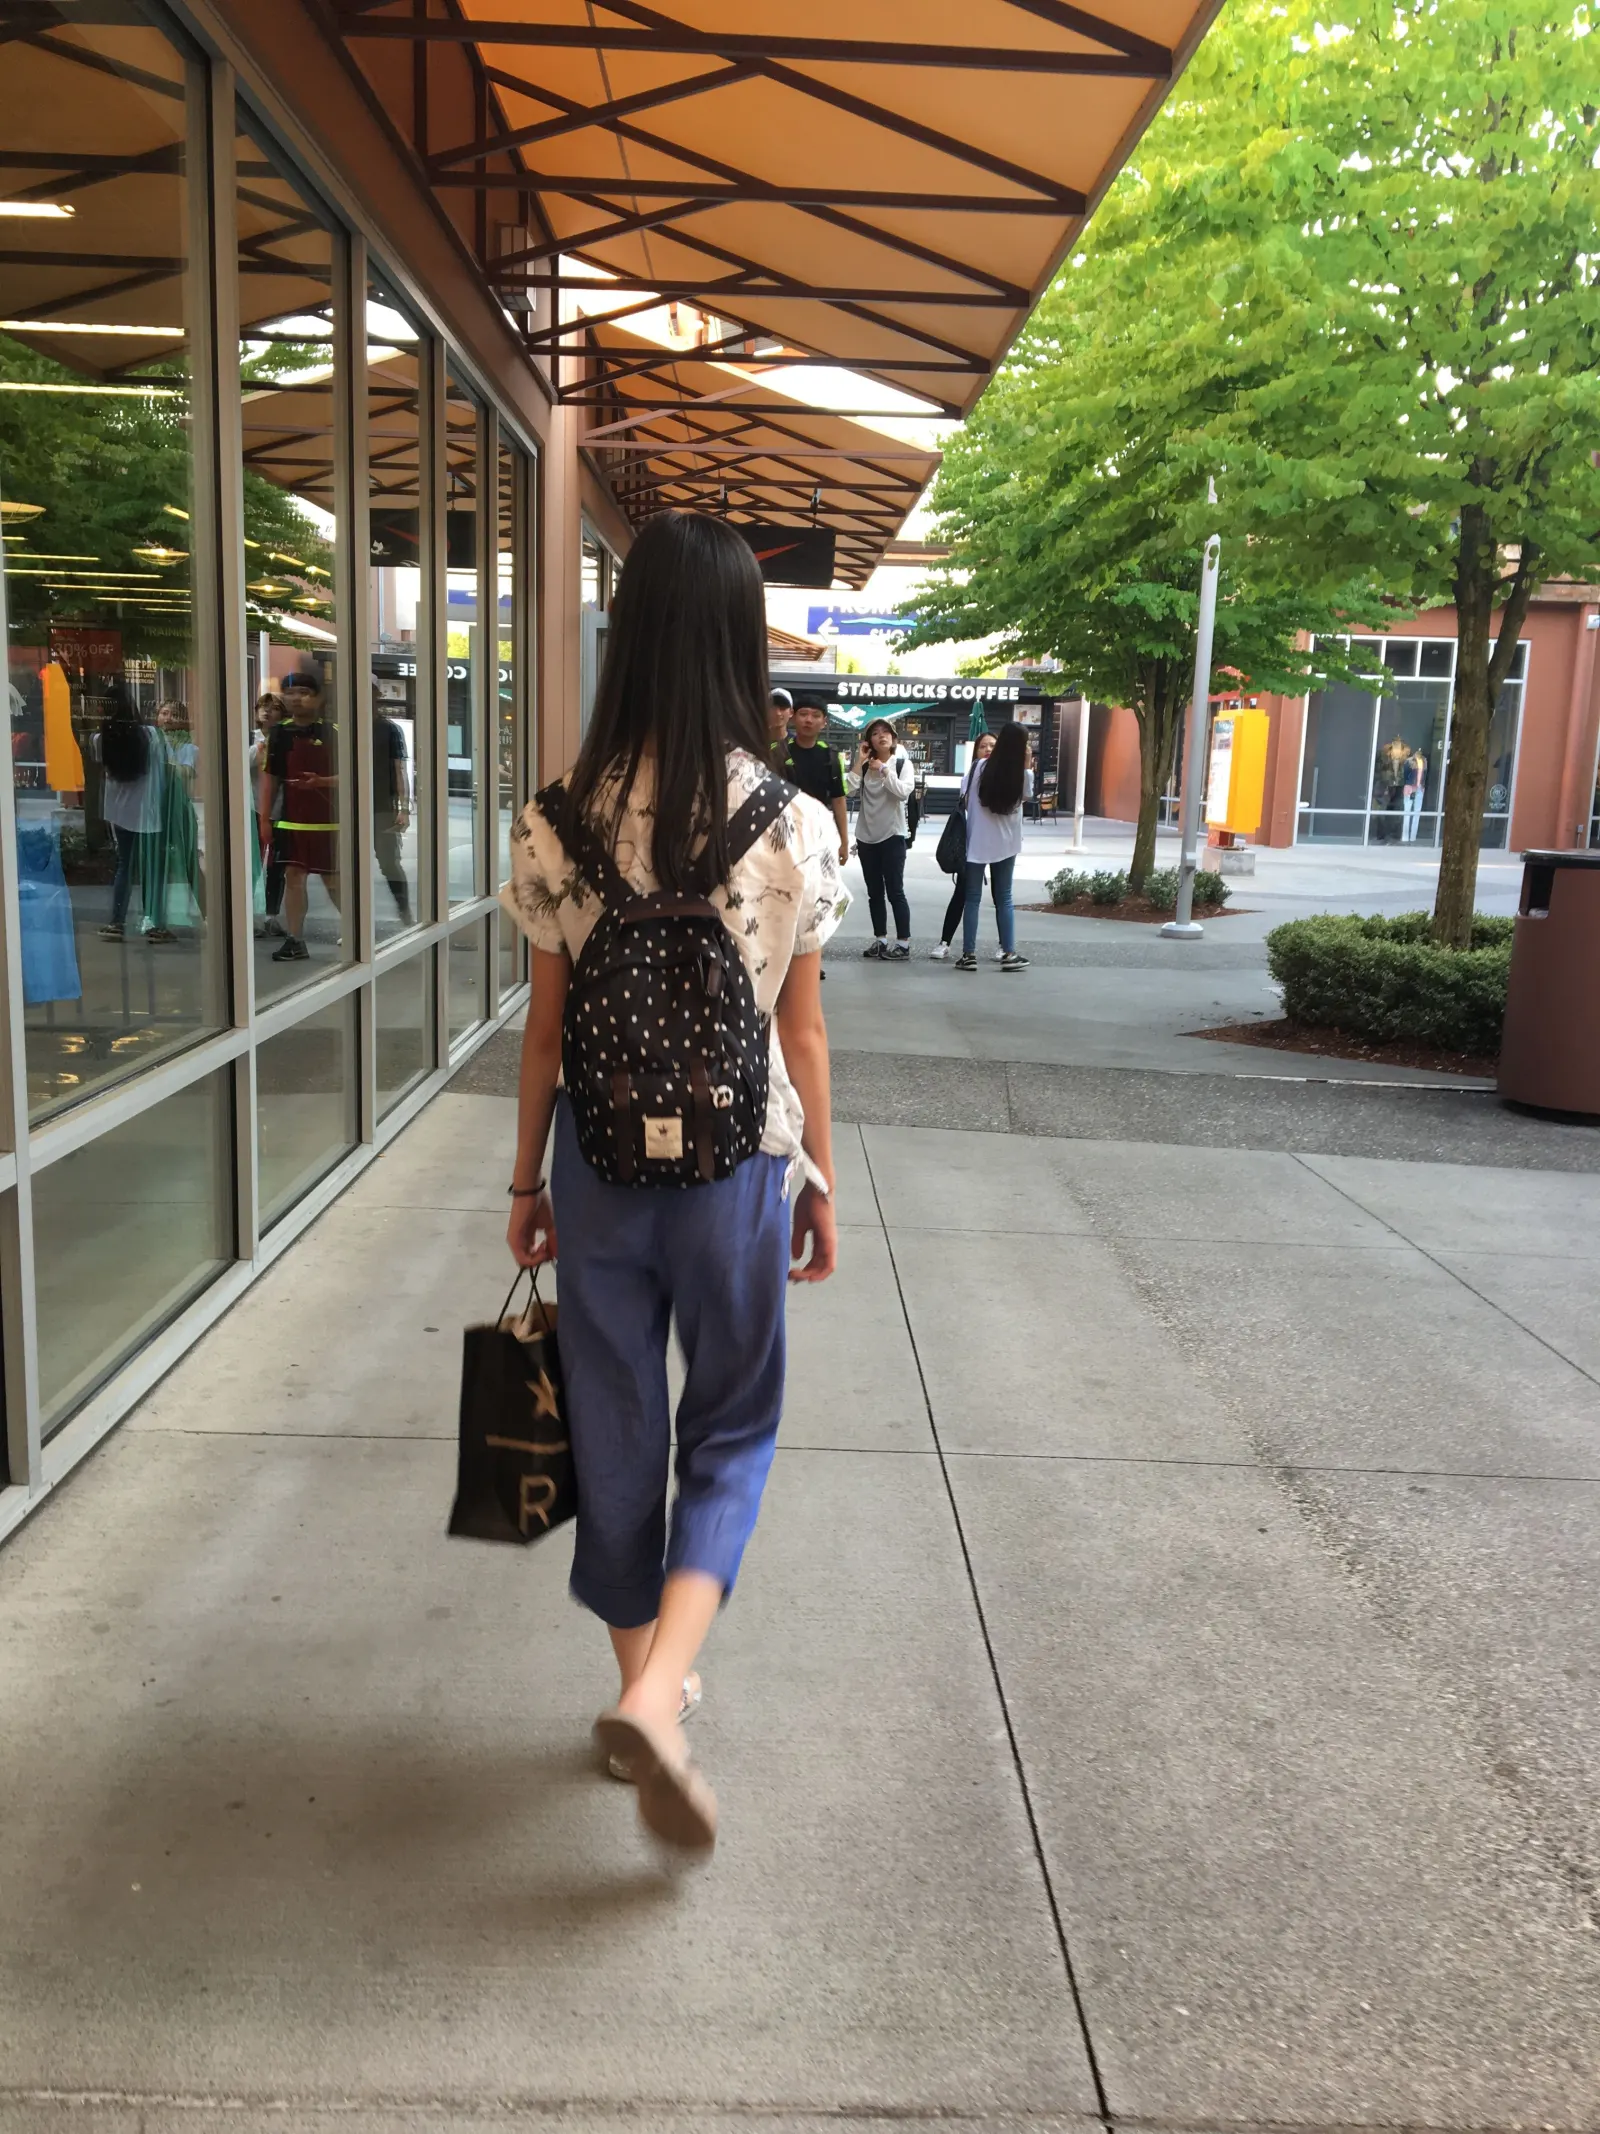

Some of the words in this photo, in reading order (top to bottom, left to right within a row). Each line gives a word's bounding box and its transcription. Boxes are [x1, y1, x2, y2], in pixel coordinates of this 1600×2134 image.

[89, 643, 114, 655] OFF
[124, 659, 141, 669] NIKE
[141, 660, 157, 670] PRO
[837, 682, 948, 699] STARBUCKS
[951, 685, 1020, 700] COFFEE
